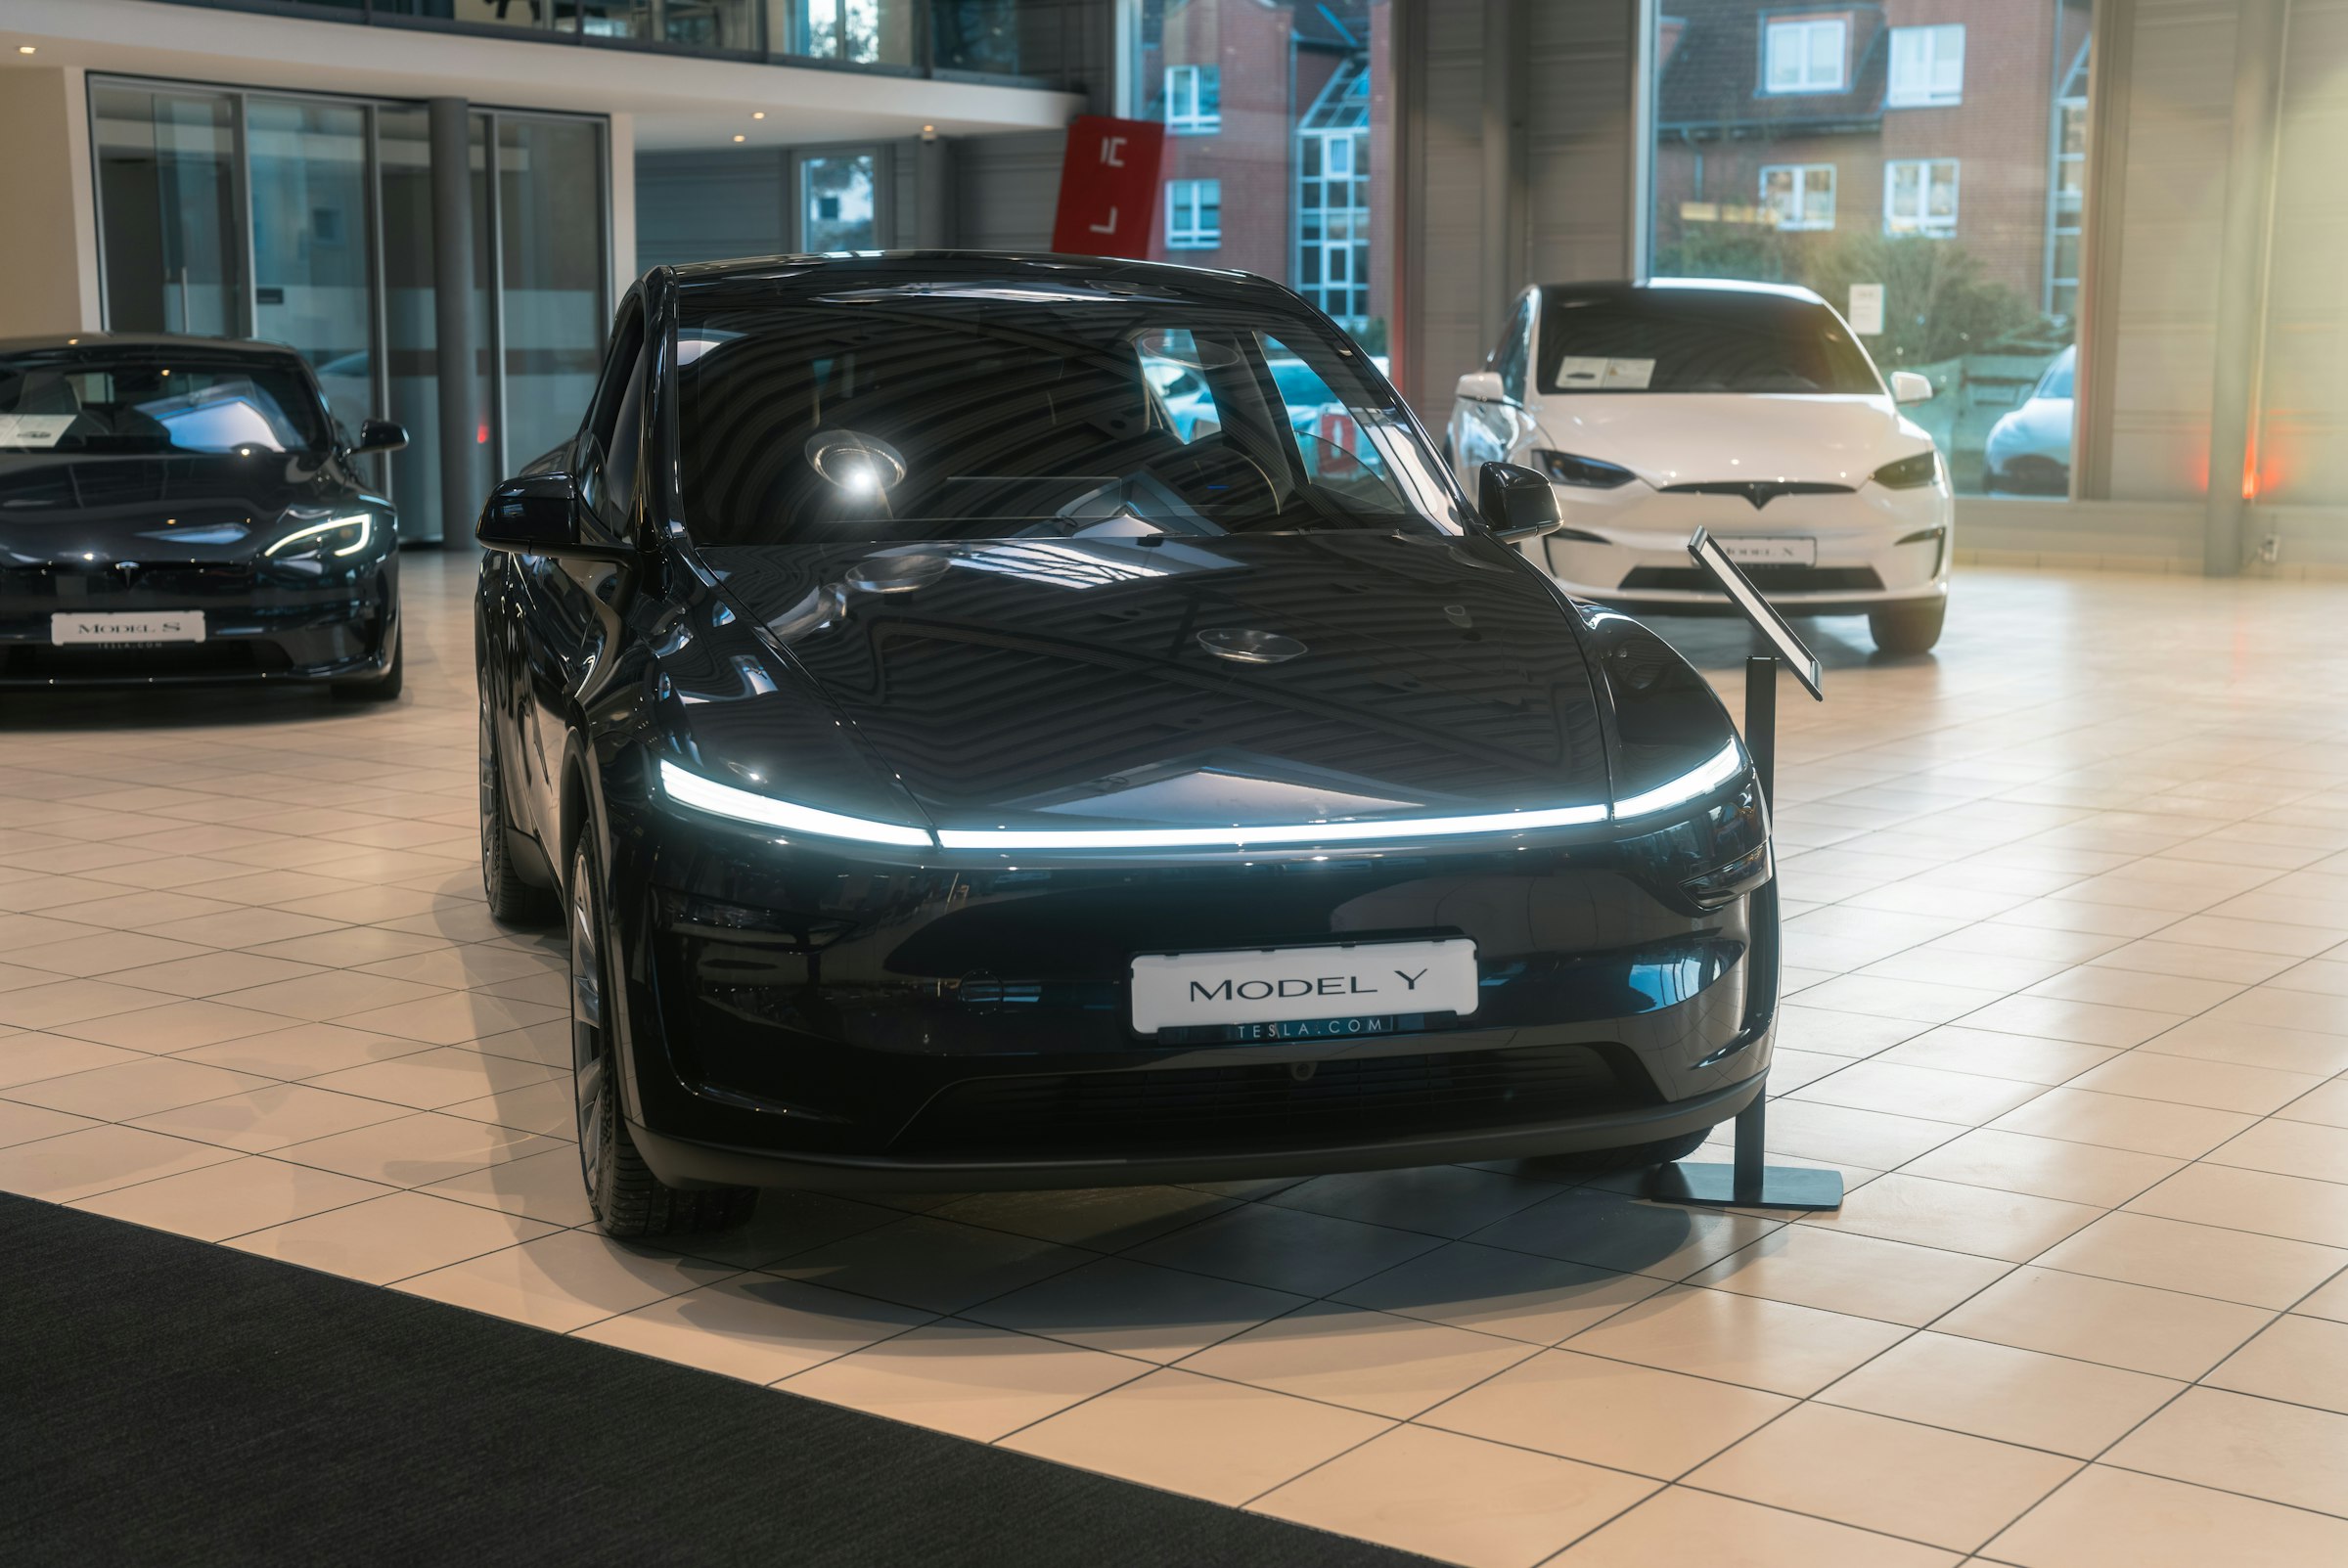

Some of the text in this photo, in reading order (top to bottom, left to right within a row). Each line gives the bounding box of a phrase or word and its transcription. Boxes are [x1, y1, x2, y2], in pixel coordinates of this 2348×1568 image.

[77, 621, 182, 635] MODEL S
[1190, 967, 1428, 1003] MODEL Y
[1237, 1018, 1381, 1039] TESLA.COM
